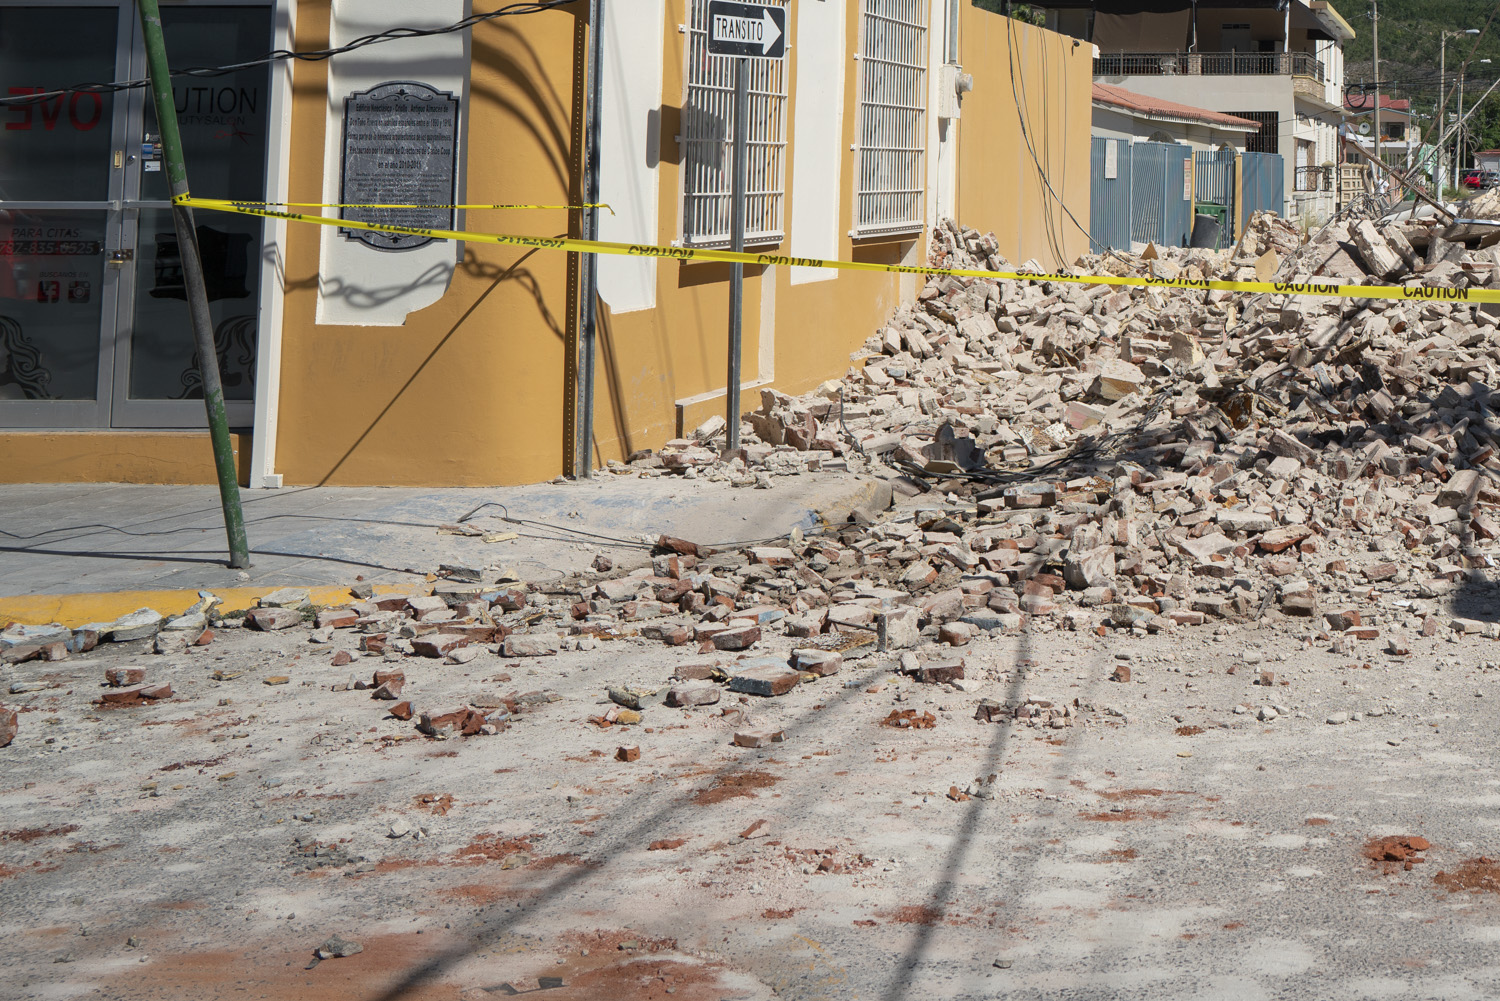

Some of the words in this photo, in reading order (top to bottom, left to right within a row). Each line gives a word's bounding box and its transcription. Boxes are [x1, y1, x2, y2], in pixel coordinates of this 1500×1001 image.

[716, 17, 763, 41] TRANSITO
[12, 228, 43, 238] PARA
[1403, 286, 1468, 300] CAUTION
